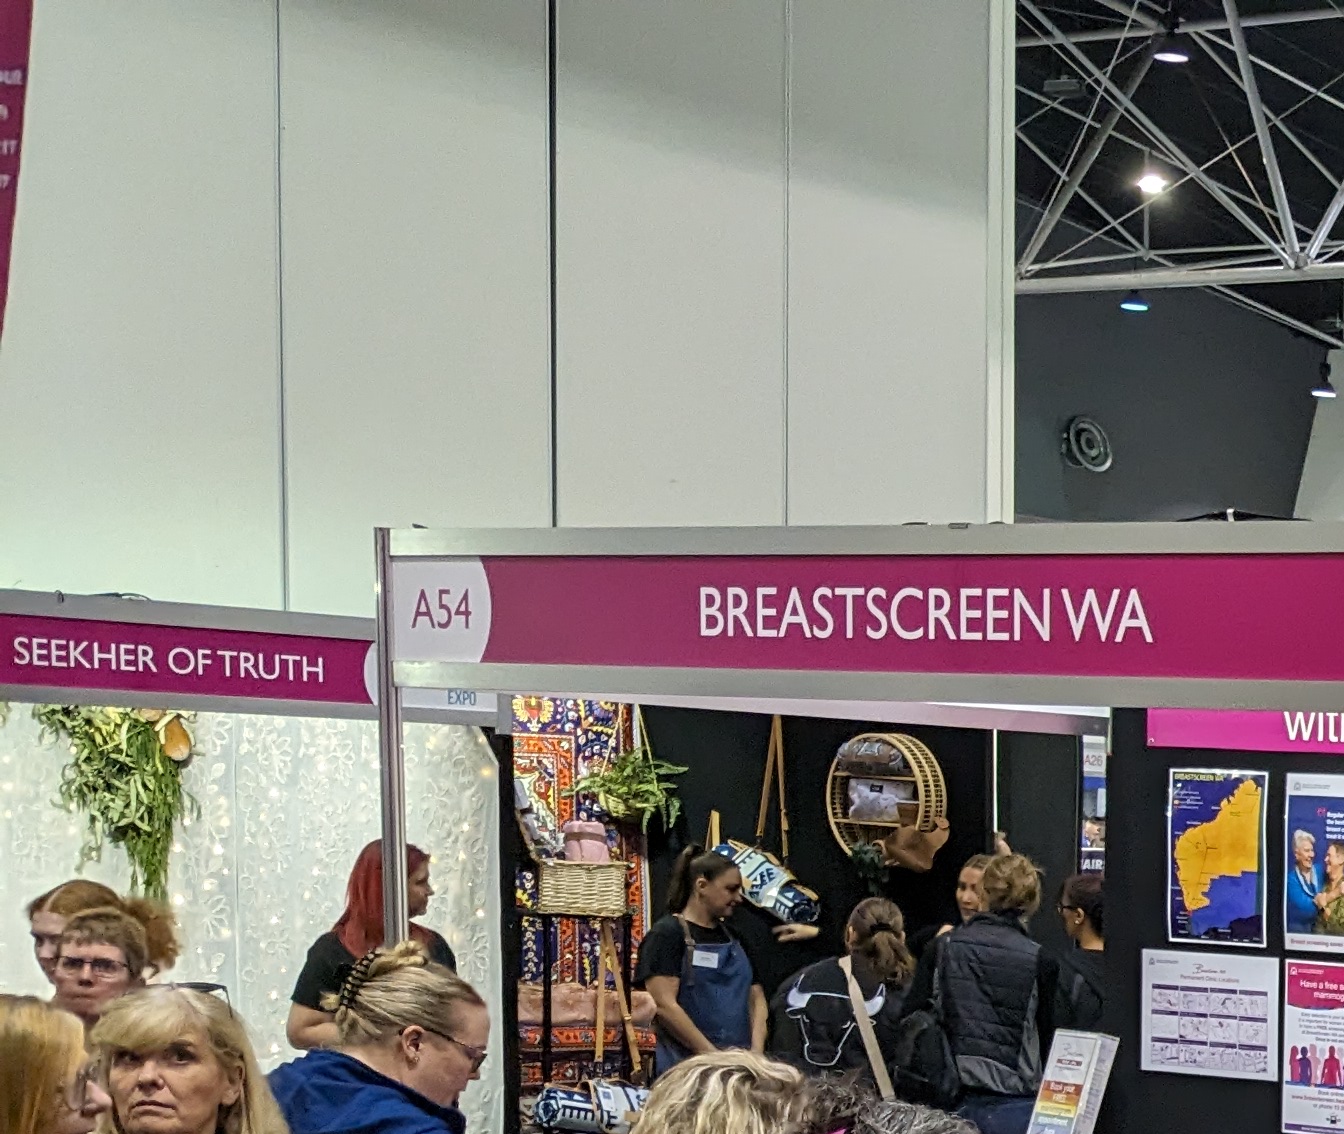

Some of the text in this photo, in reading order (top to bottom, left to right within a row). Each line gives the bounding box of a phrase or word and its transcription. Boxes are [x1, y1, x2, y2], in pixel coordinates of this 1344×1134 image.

[411, 589, 473, 630] A54
[699, 586, 1155, 645] BREASTSCREEN WA
[13, 636, 324, 684] SEEKHER OF TRUTH
[447, 690, 477, 707] EXPO
